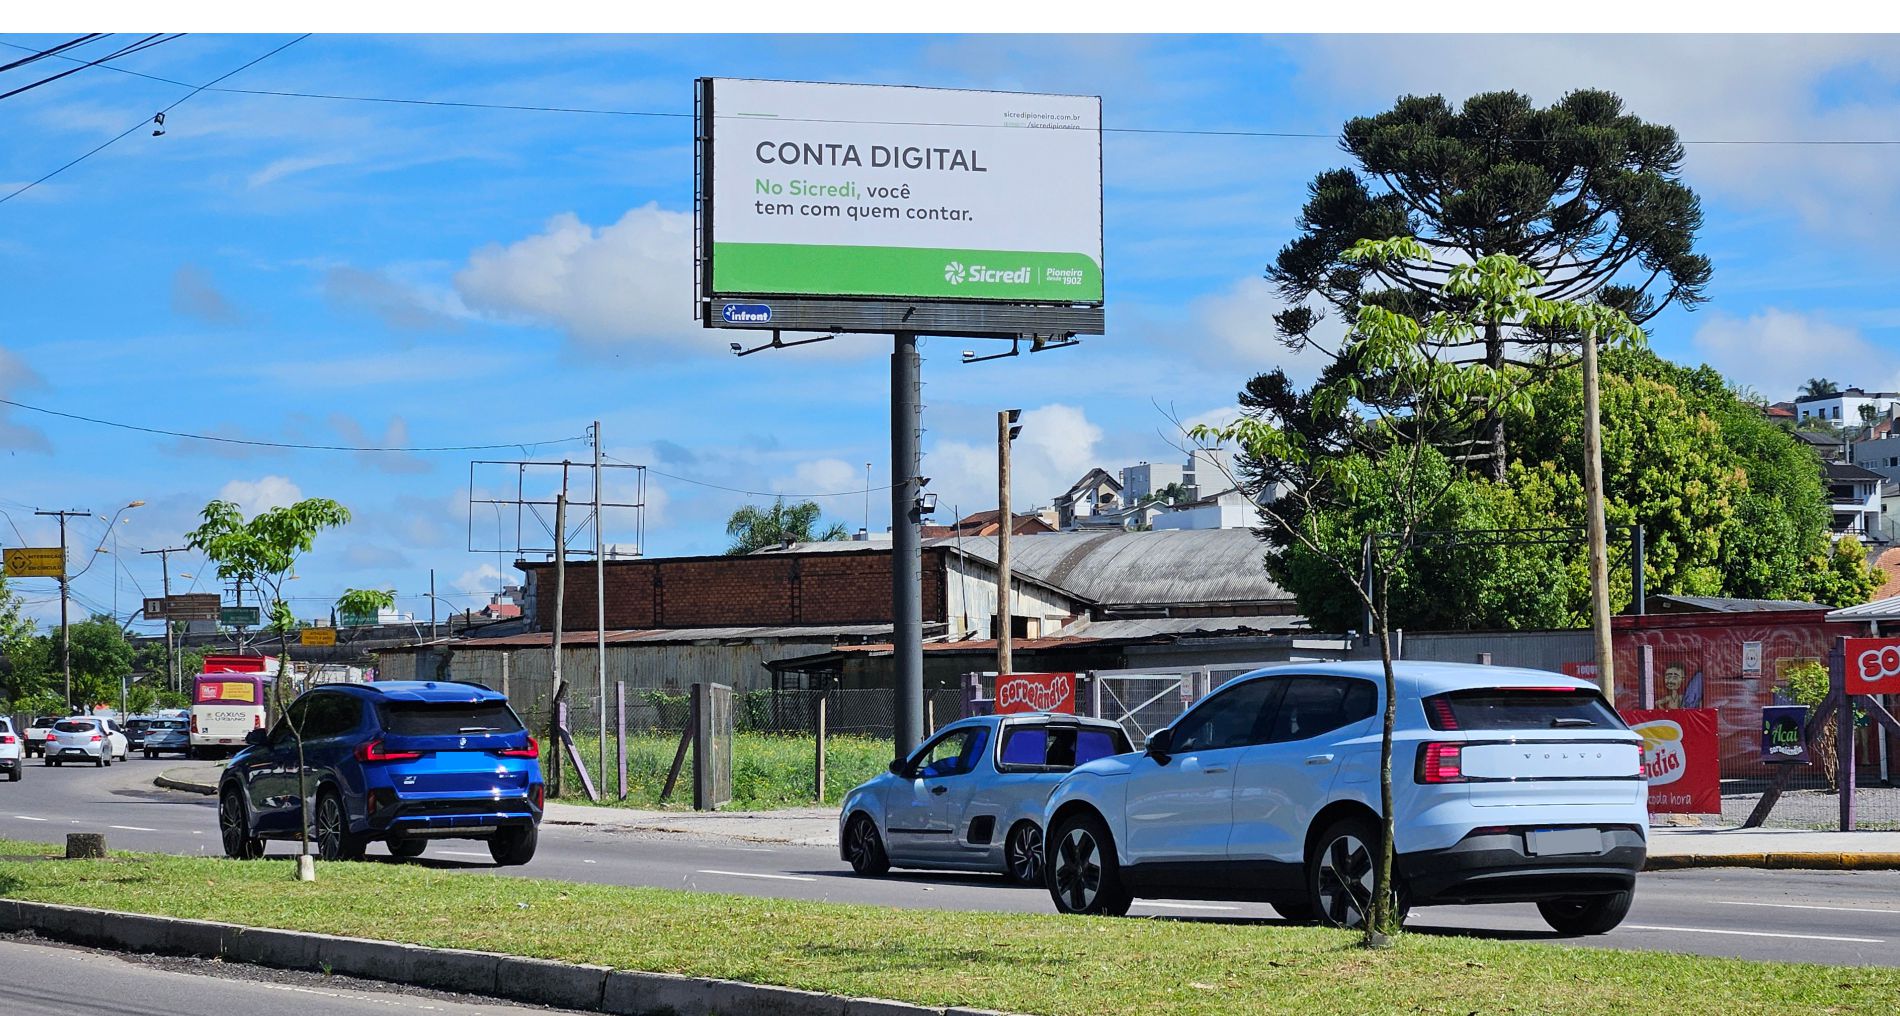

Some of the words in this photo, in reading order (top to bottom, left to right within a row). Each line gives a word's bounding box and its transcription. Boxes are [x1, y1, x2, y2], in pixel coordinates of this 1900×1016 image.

[1003, 111, 1080, 121] sicredipioneira.com.br
[755, 141, 862, 167] CONTA
[871, 145, 988, 172] DIGITAL
[755, 178, 783, 195] No
[789, 180, 861, 200] Sicredi,
[867, 184, 911, 199] você
[755, 200, 794, 215] tem
[800, 204, 840, 217] com
[847, 206, 900, 221] quem
[906, 206, 973, 221] contar.
[968, 265, 1031, 284] Sicredi
[1046, 268, 1083, 276] Pioneira
[1063, 276, 1082, 285] 1902
[731, 311, 768, 321] infront
[1771, 723, 1799, 746] Açaí
[1670, 792, 1692, 806] hora
